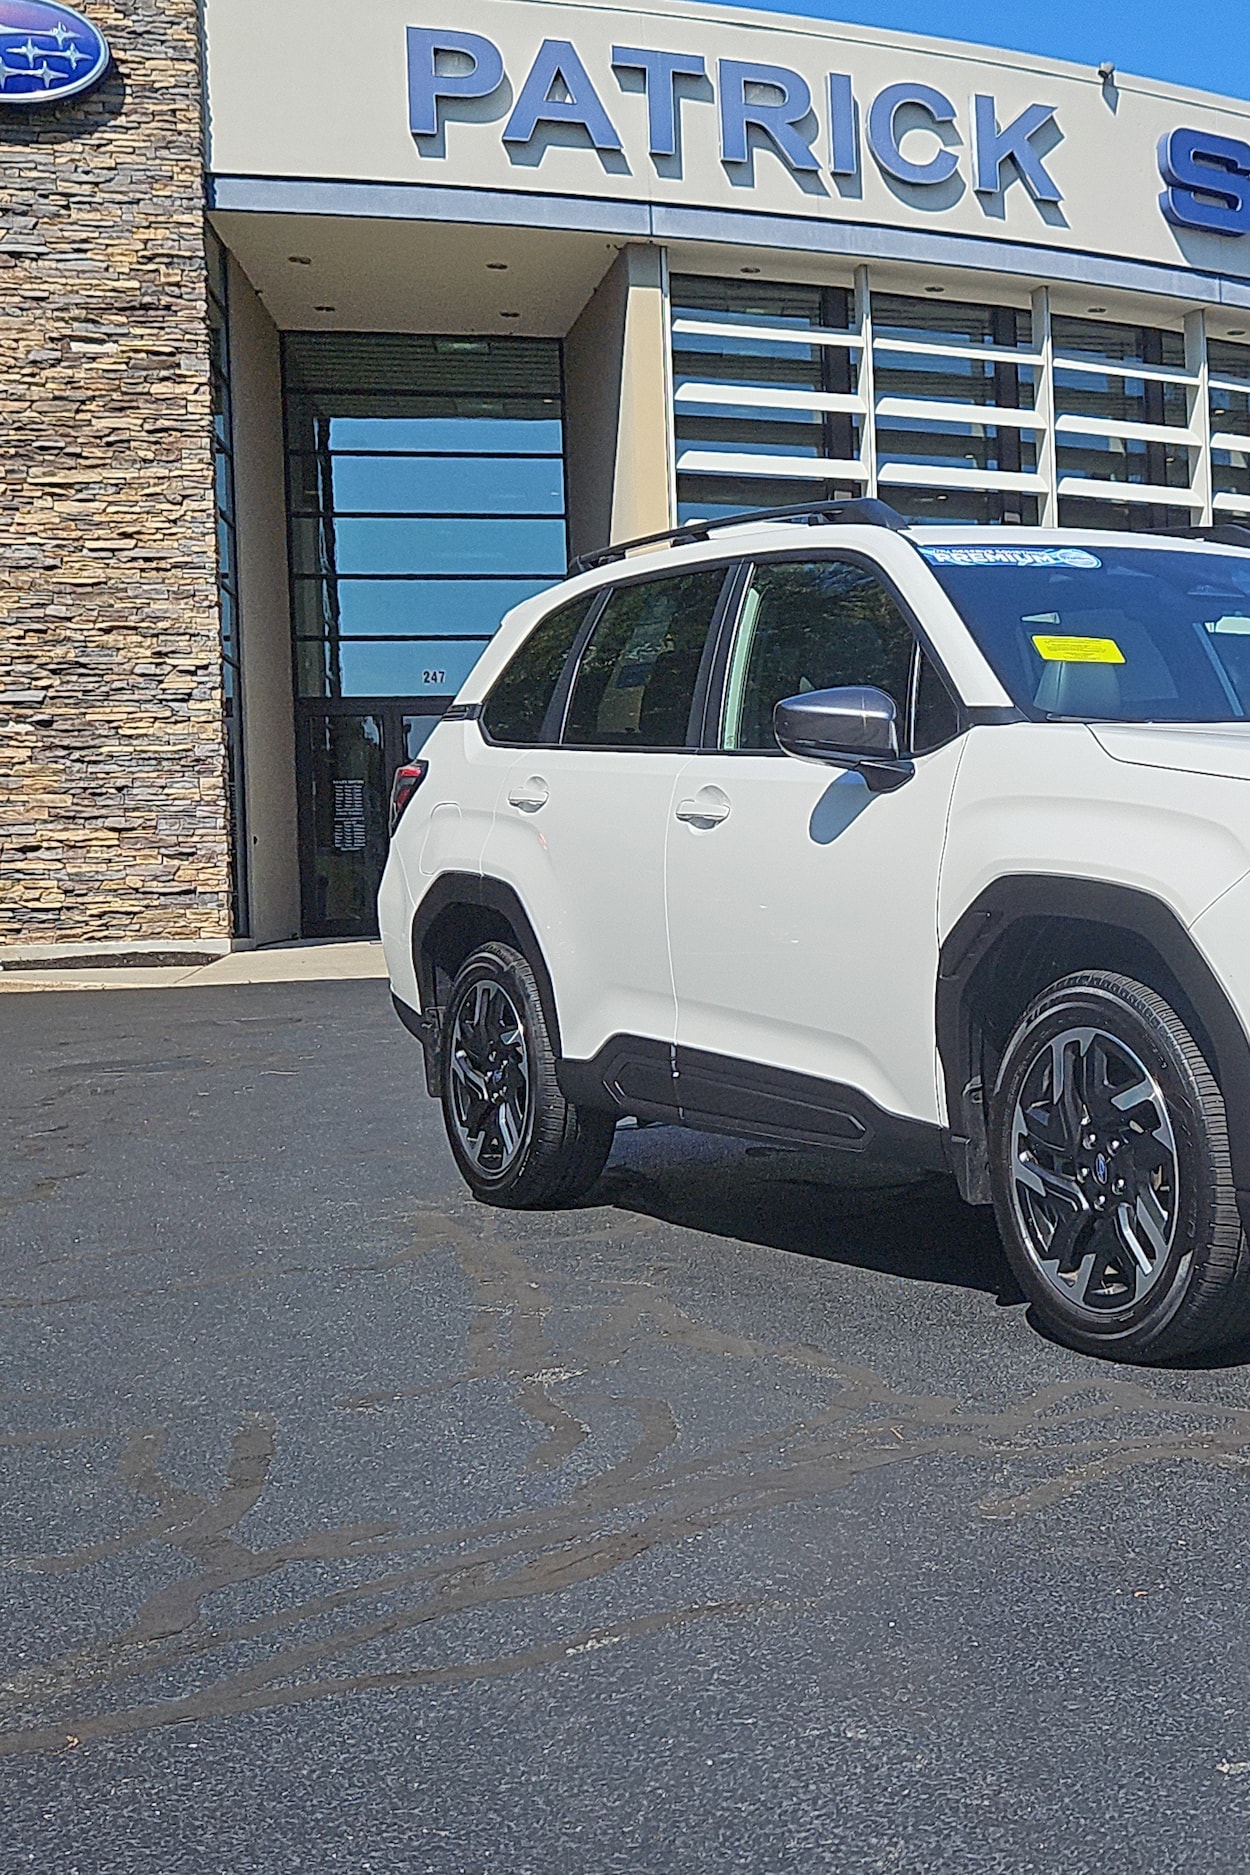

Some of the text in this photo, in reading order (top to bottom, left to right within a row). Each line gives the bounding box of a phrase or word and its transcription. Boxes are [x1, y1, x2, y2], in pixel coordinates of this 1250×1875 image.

[406, 26, 1064, 202] PATRICK
[933, 552, 1056, 566] PREMIUM
[423, 670, 445, 684] 247
